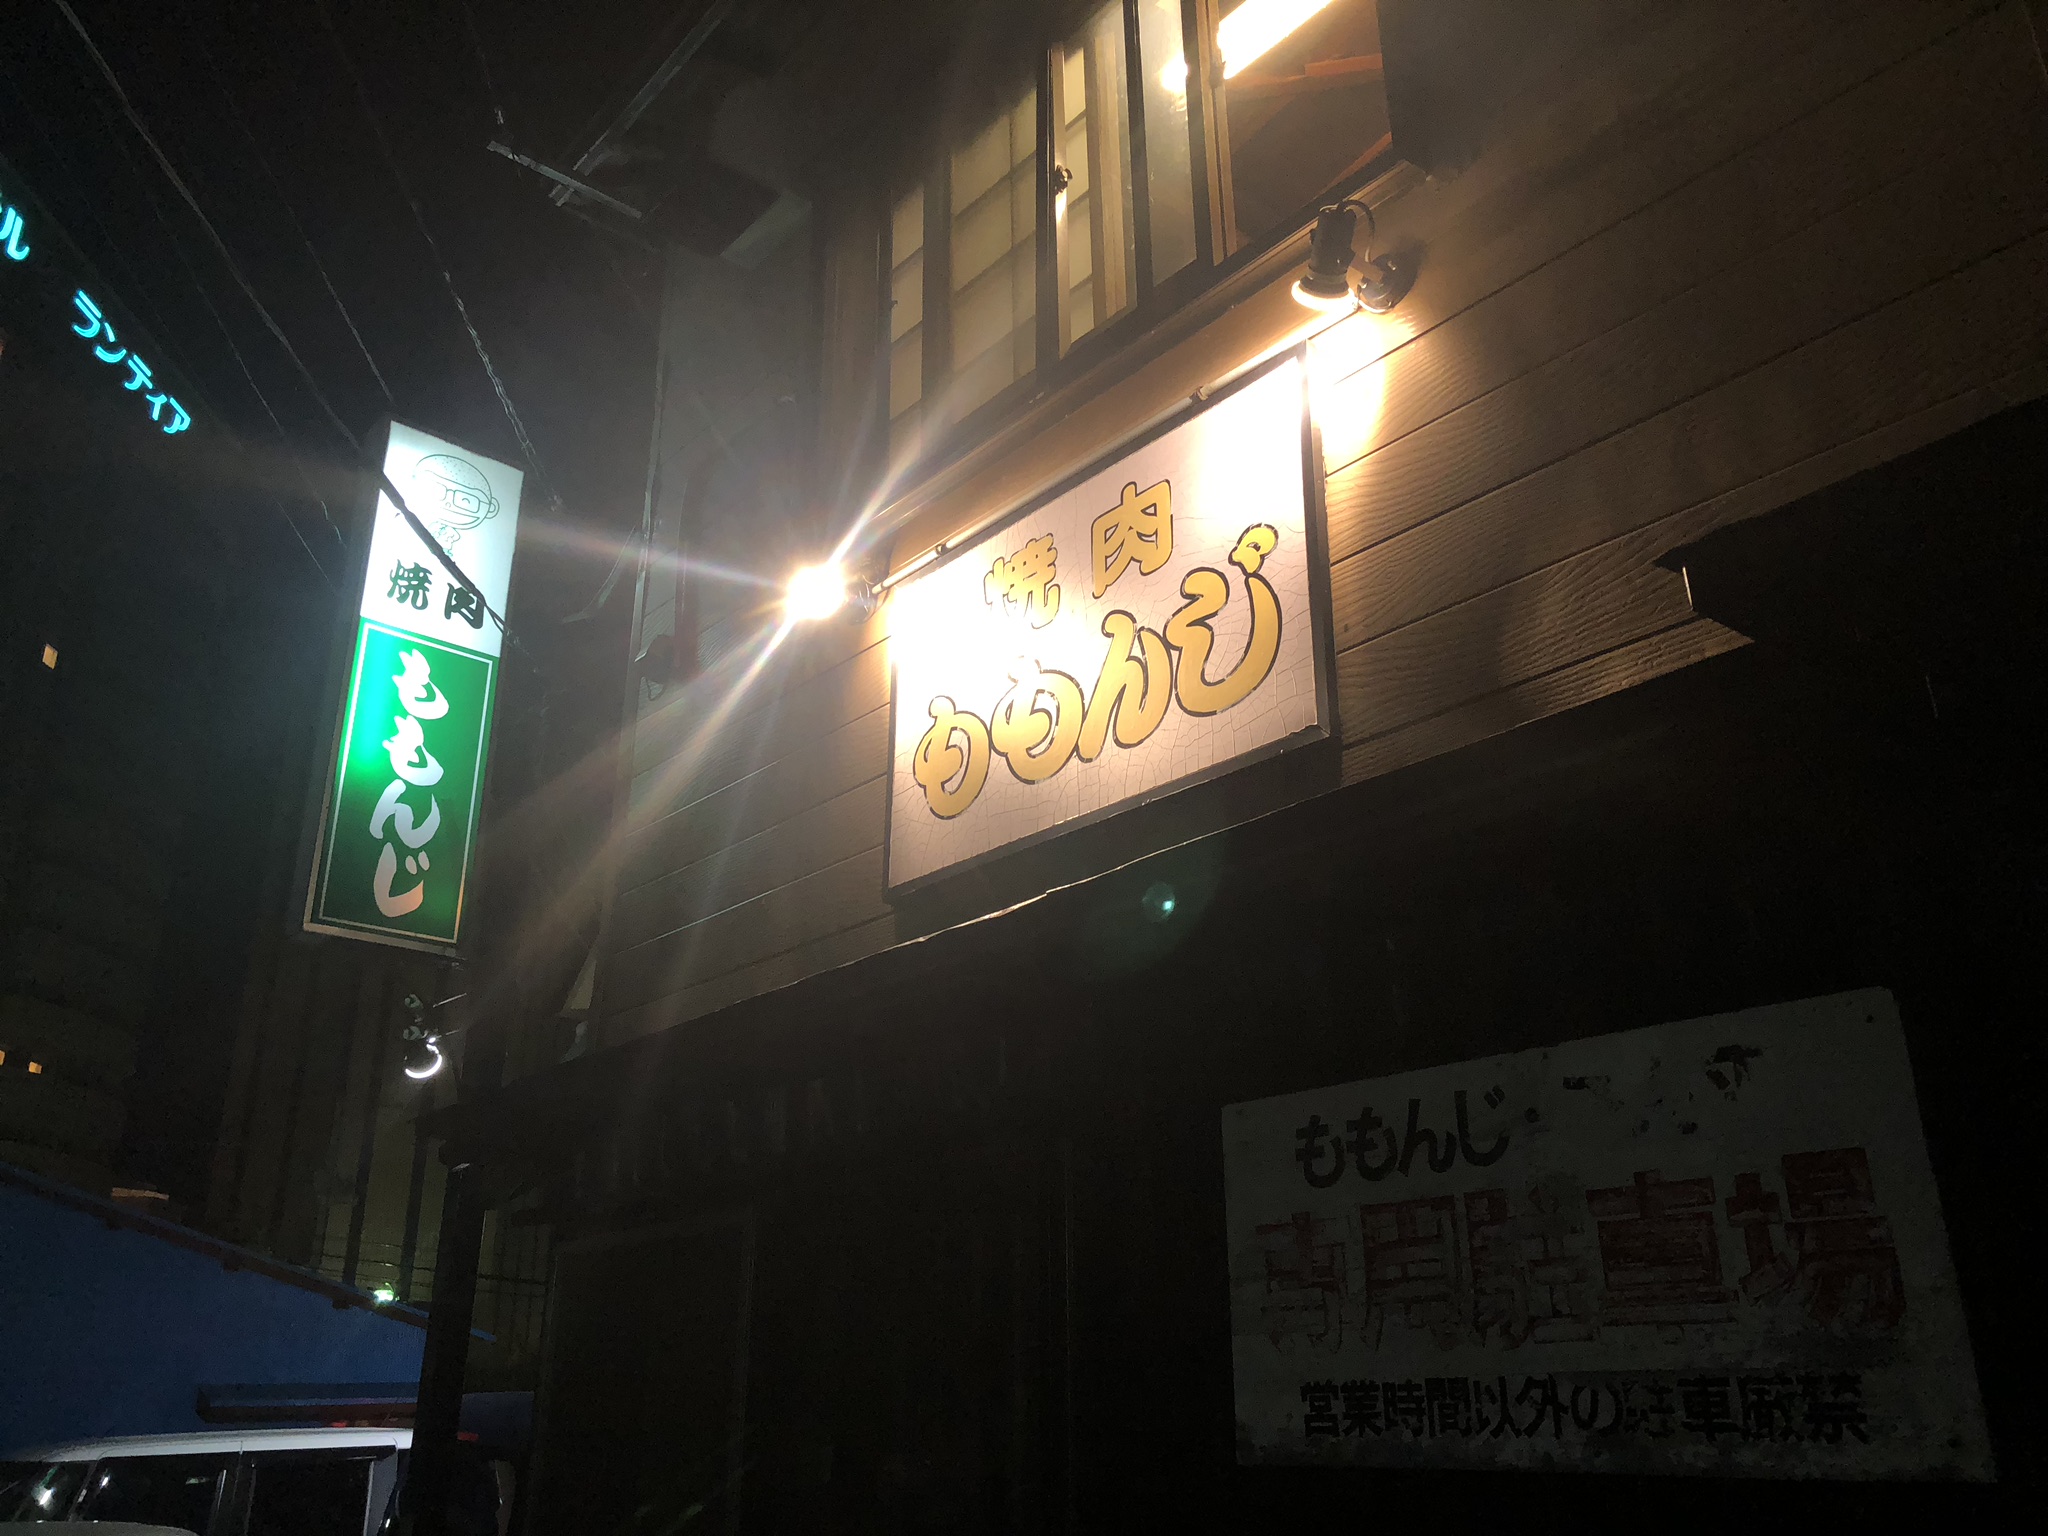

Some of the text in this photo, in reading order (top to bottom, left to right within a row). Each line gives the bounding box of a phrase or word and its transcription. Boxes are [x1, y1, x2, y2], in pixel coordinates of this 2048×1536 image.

[0, 192, 192, 434] ル ランティア
[387, 559, 485, 630] 焼肉
[983, 478, 1174, 630] 焼肉
[912, 523, 1282, 820] ももんじ
[369, 648, 450, 918] ももんじ
[1295, 1084, 1510, 1188] ももんじ
